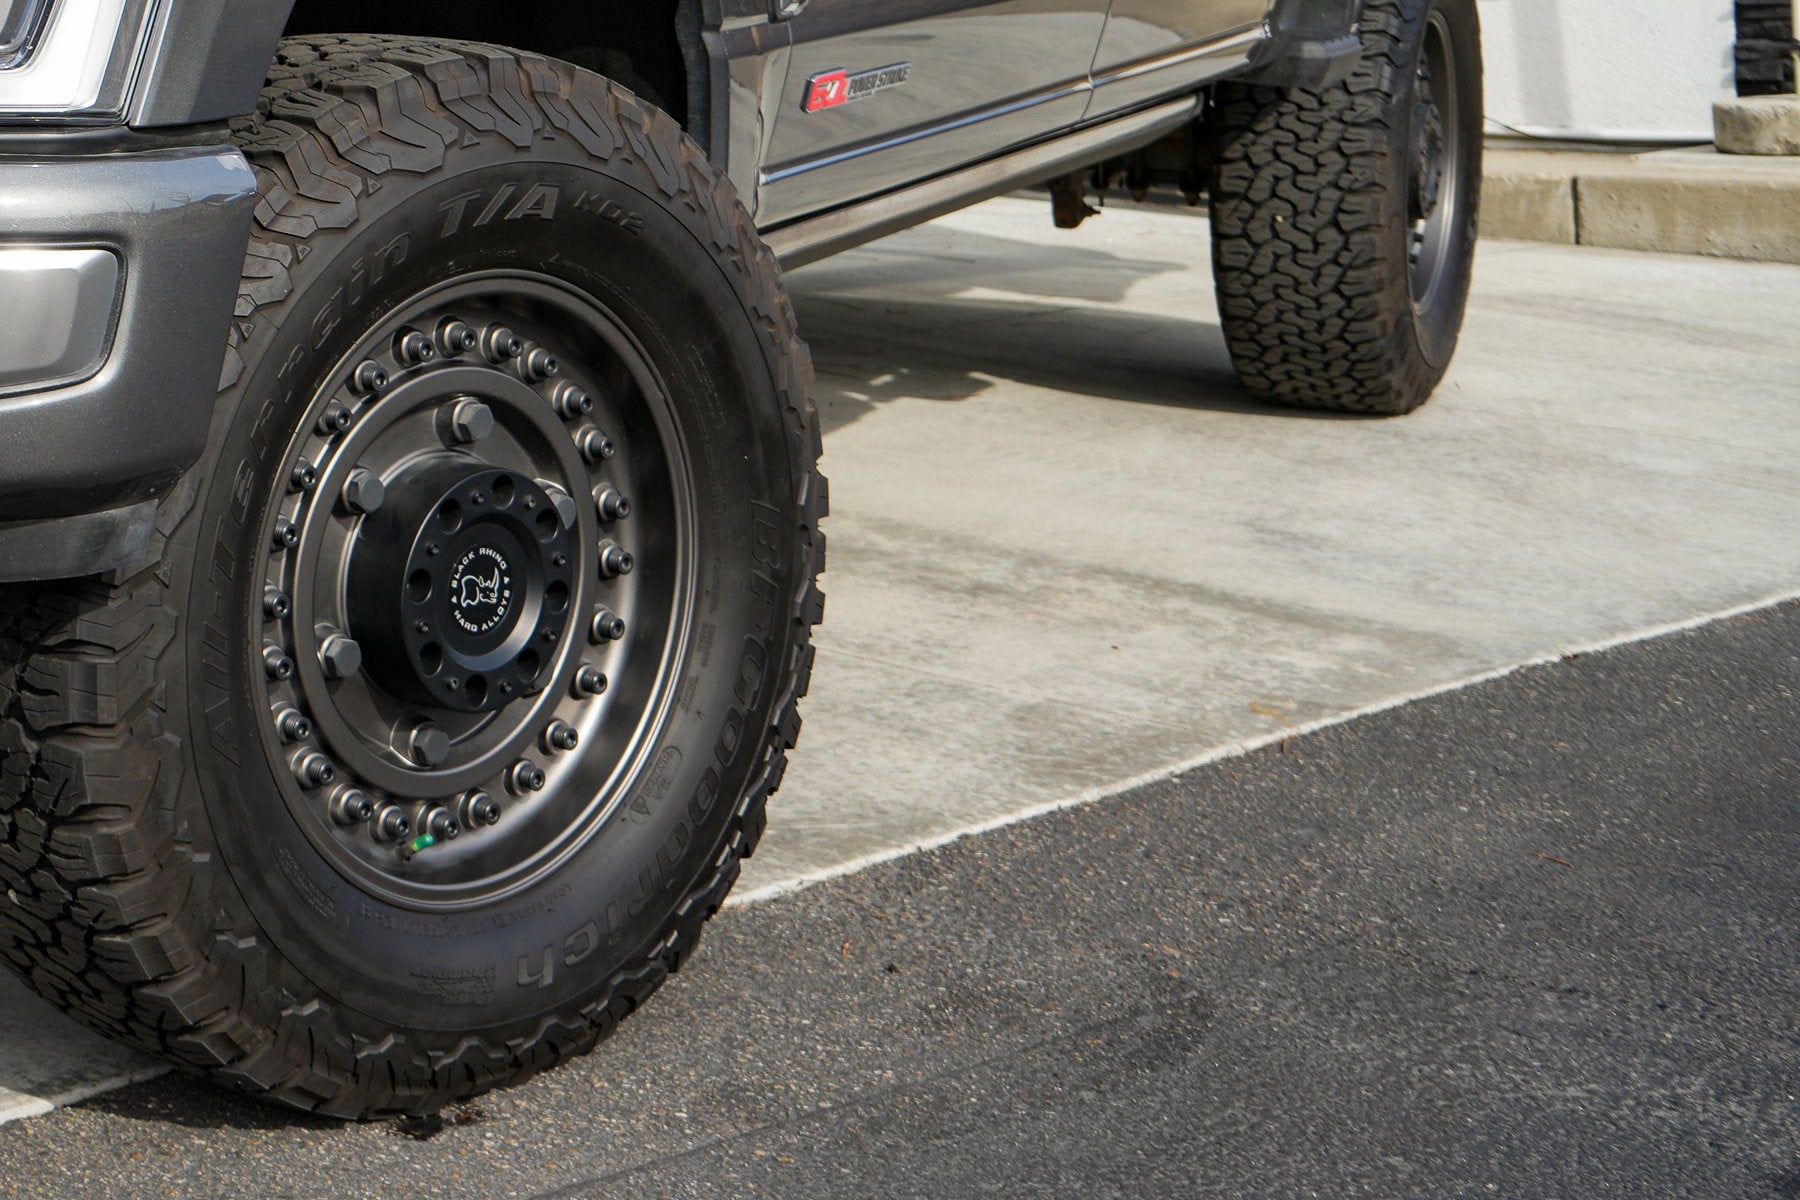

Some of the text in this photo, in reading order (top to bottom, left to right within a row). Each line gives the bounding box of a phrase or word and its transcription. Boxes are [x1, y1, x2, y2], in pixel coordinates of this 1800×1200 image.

[438, 182, 561, 239] T/A
[451, 547, 507, 588] BLACK RHINO
[454, 589, 510, 632] HARD ALLOYS
[515, 499, 782, 989] BFGoodrich
